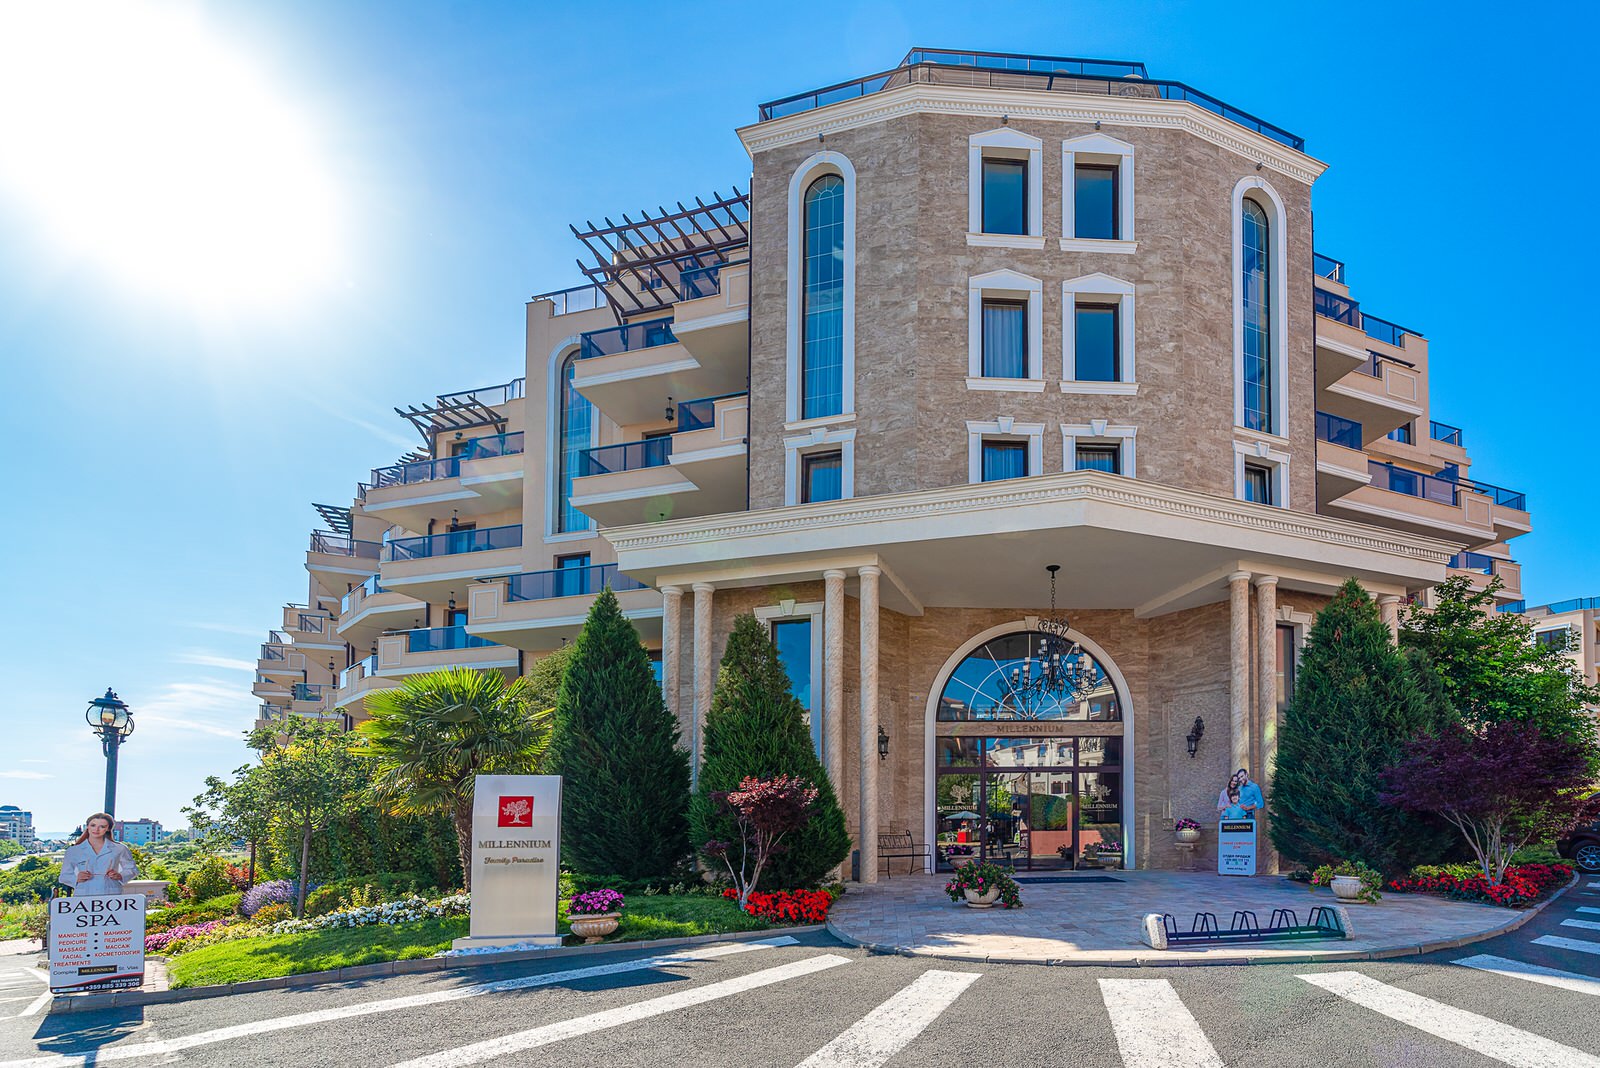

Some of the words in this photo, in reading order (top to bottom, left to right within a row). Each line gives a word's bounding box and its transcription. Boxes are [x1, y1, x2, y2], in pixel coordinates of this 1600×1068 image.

[996, 725, 1064, 733] MILLENNIUM
[478, 840, 552, 849] MILLENNIUM
[484, 857, 511, 865] Family
[511, 856, 544, 864] Paradise
[58, 898, 138, 914] BABOR
[76, 914, 120, 928] SPA
[94, 950, 141, 958] КОСМЕТОЛОГИЯ
